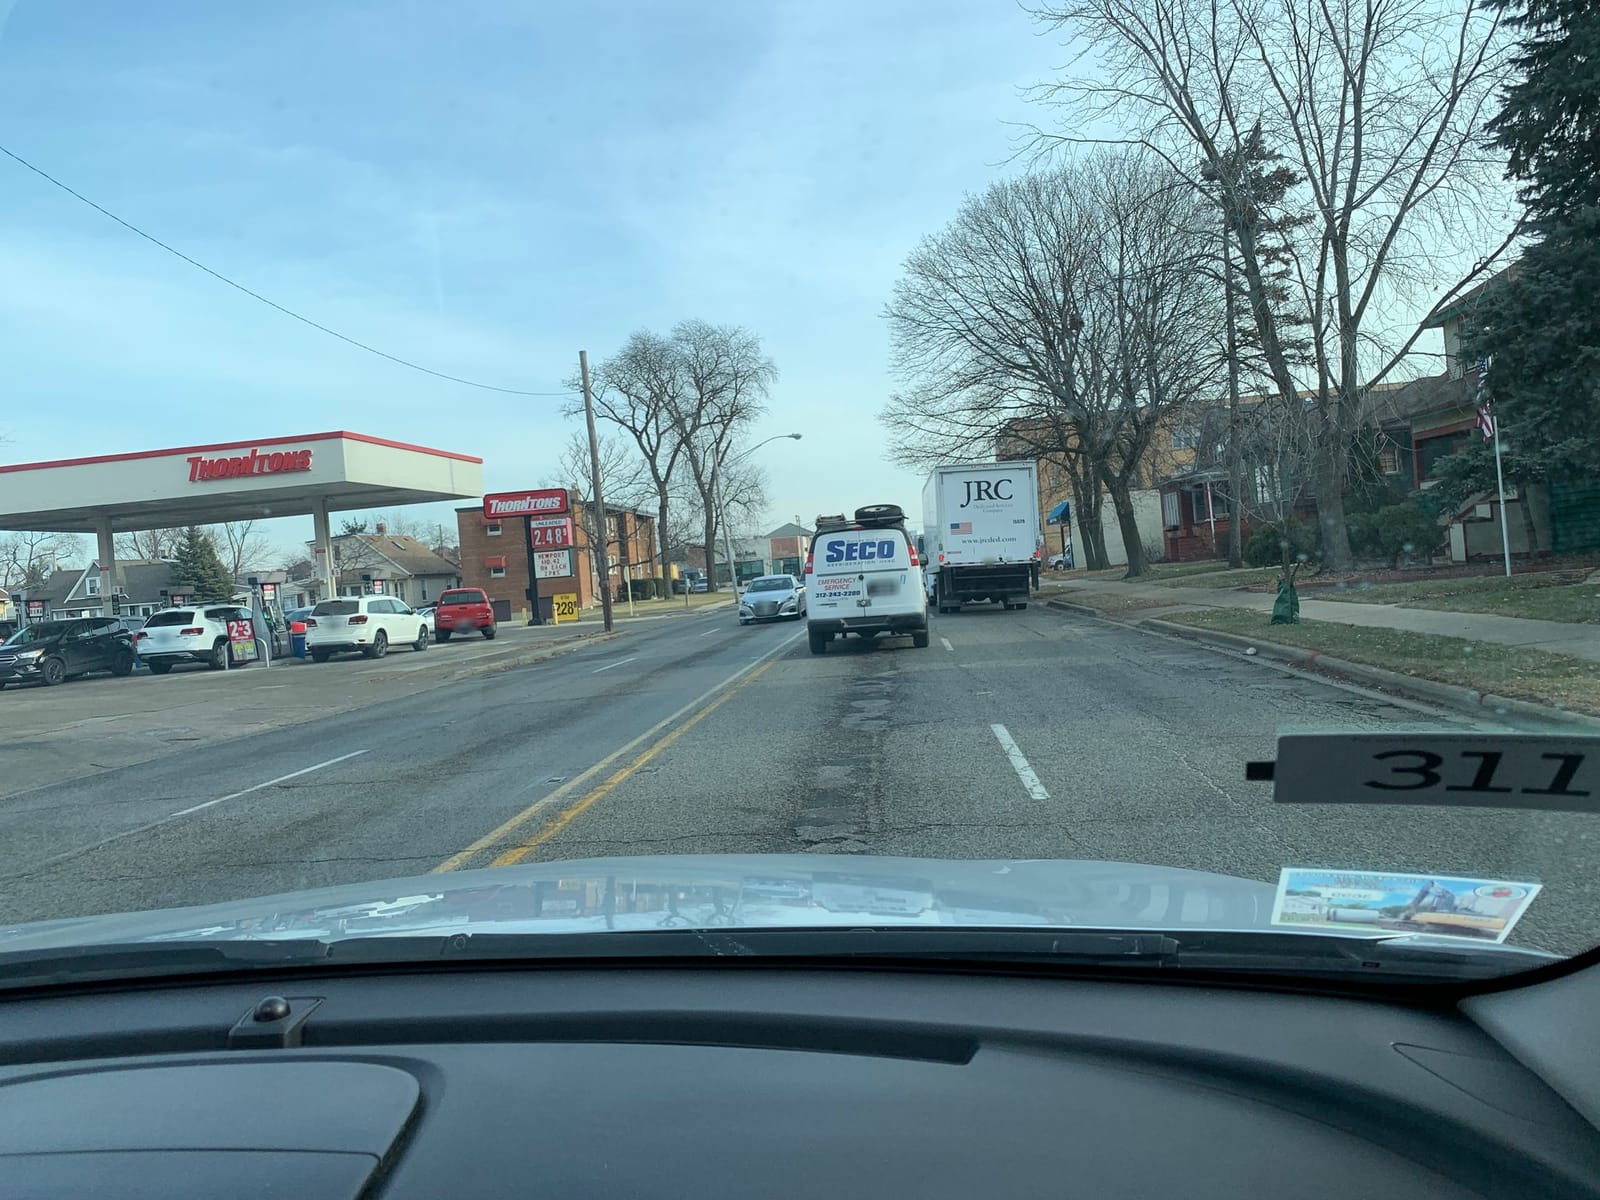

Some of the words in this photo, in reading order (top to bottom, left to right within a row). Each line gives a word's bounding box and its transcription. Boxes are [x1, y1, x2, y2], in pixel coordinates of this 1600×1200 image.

[187, 449, 312, 482] THORNTONS
[489, 496, 561, 514] THORNTONS
[960, 479, 1013, 508] JRC
[826, 540, 895, 563] SECO
[817, 577, 856, 585] EMERGENCY
[1364, 750, 1590, 797] 311
